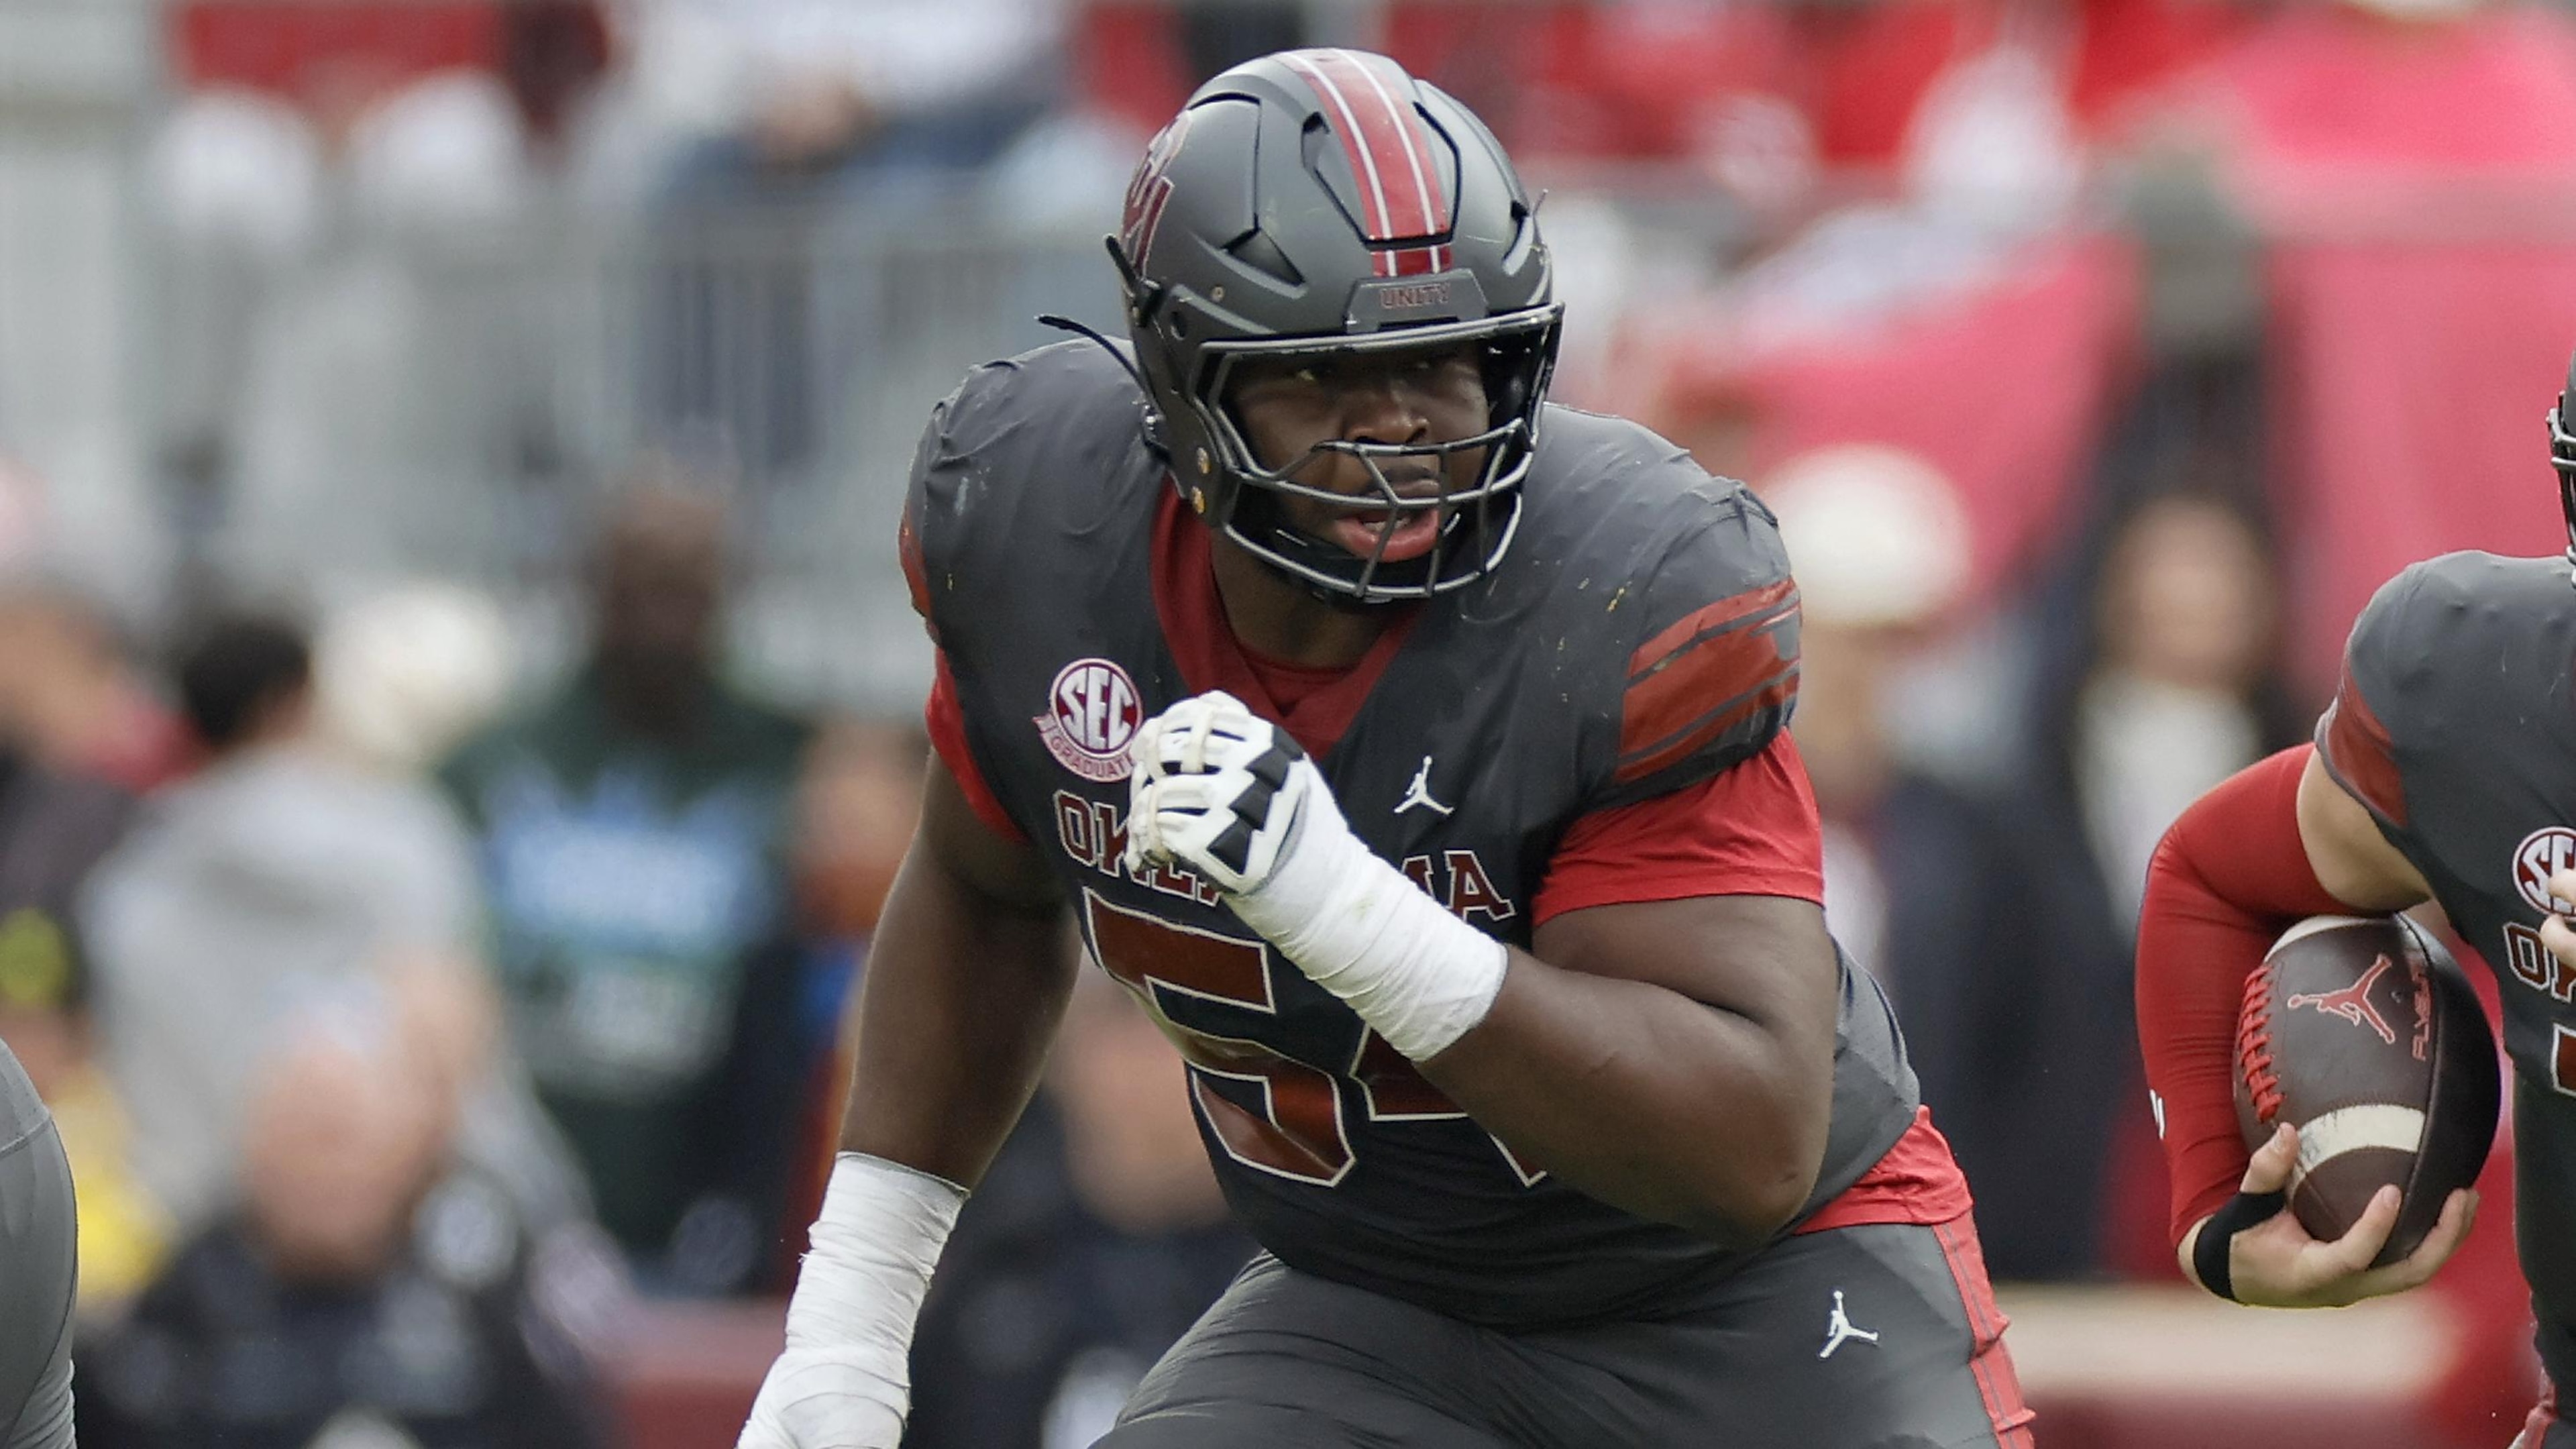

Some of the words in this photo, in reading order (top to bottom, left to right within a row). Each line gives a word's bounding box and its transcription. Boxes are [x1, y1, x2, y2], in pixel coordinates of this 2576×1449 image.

[1380, 282, 1451, 309] UNITY
[1059, 666, 1135, 751] SEC
[1051, 735, 1137, 777] GRADUAT
